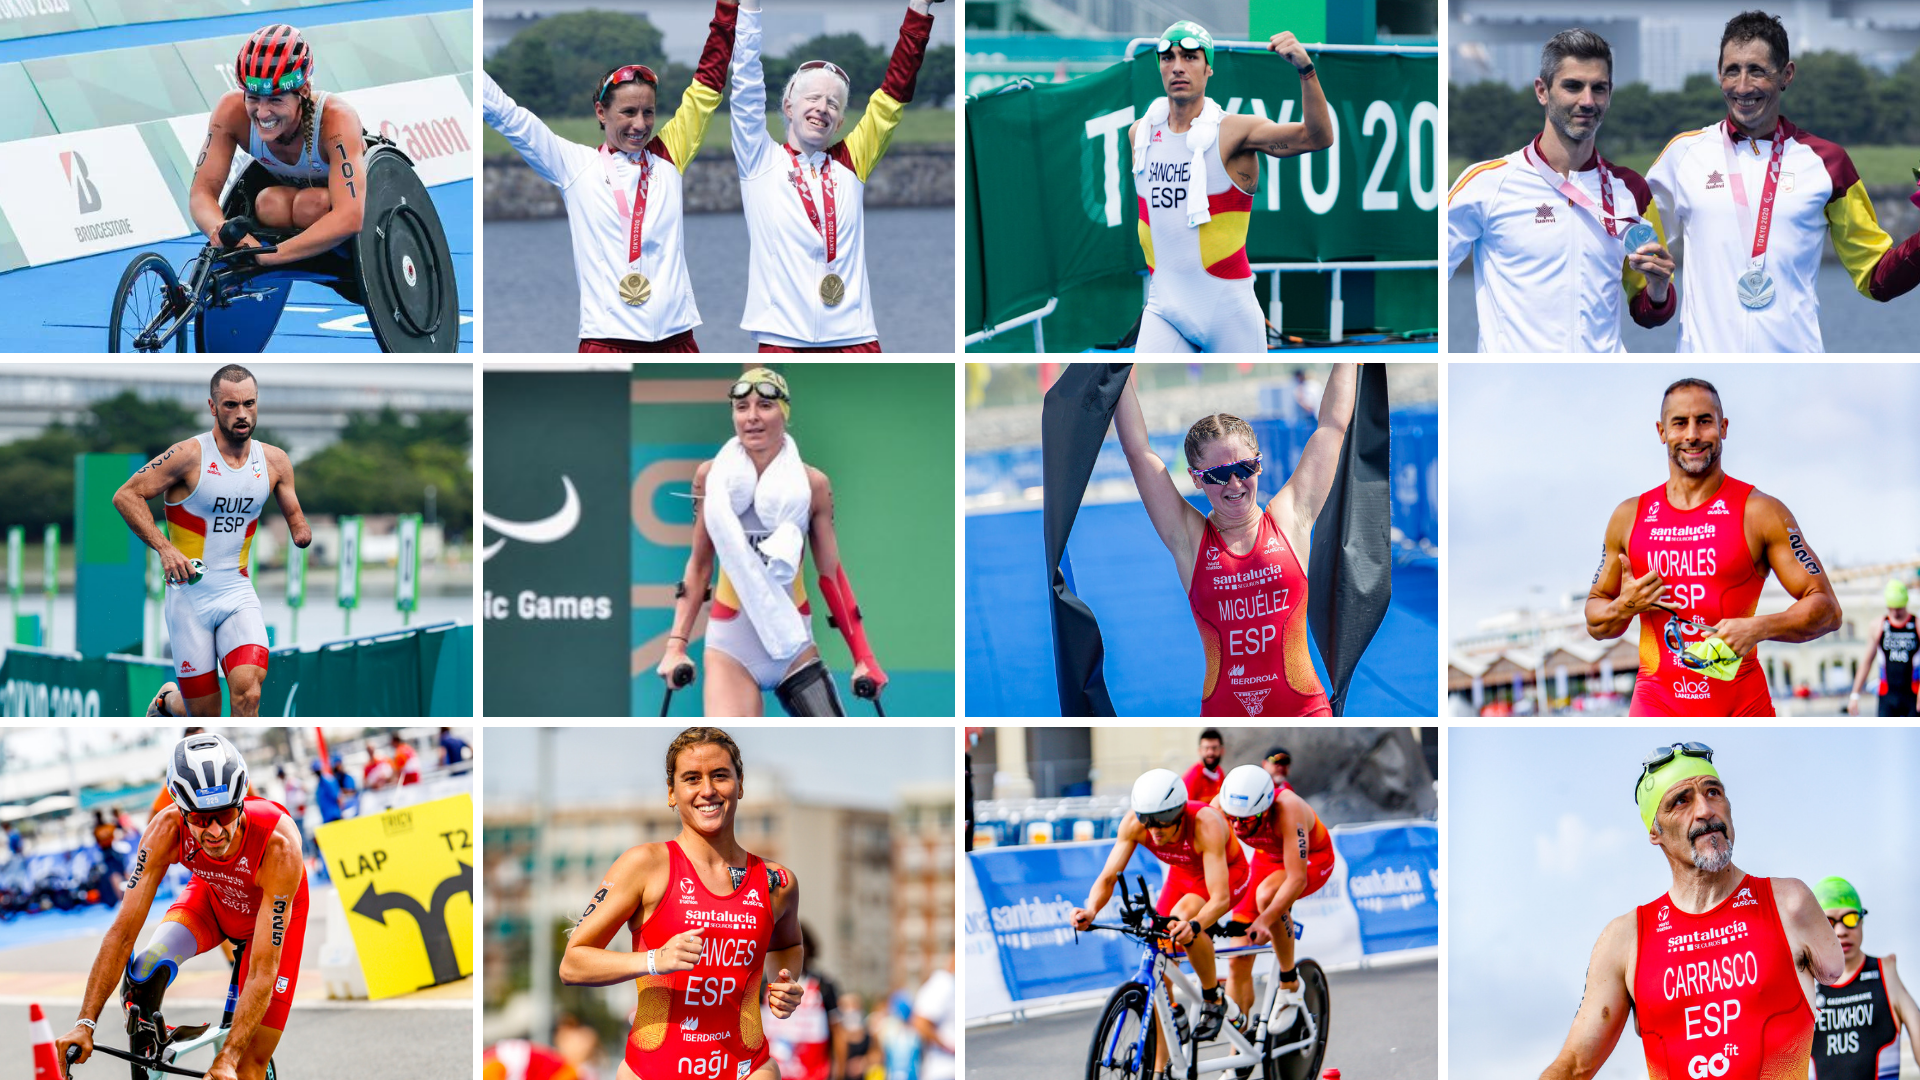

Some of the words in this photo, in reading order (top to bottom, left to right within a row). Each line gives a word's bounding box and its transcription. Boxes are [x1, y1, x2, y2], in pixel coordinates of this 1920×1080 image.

[282, 79, 294, 91] 101
[380, 115, 471, 162] Canon
[1085, 96, 1341, 229] TYO
[1151, 186, 1187, 209] ESP
[1760, 207, 1770, 225] 2020
[74, 217, 134, 243] BRIDGESTONE
[1756, 225, 1768, 248] TOKYO
[632, 233, 640, 254] TOKYO
[212, 496, 254, 514] RUIZ
[213, 516, 245, 533] ESP
[1650, 522, 1717, 537] santalucía
[1647, 547, 1717, 578] MORALES
[1788, 533, 1822, 576] 223
[1213, 563, 1283, 586] santalucía
[517, 589, 612, 620] Games
[1217, 588, 1291, 622] MIGUÉLEZ
[1229, 624, 1277, 656] ESP
[1230, 672, 1279, 685] IBERDROLA
[1673, 675, 1710, 693] aloe
[0, 677, 48, 717] OKYO
[1674, 692, 1711, 700] LANZAROTE
[205, 796, 219, 805] 325
[439, 829, 473, 851] T2
[1296, 827, 1308, 859] 628
[339, 850, 388, 879] LAP
[576, 887, 609, 927] 40
[1732, 898, 1759, 909] austral
[271, 900, 288, 947] 325
[685, 909, 757, 925] santalucía
[1667, 919, 1748, 948] santalucía
[1694, 939, 1721, 950] SEGUROS
[697, 937, 757, 967] ANCES
[1663, 950, 1758, 1001] CARRASCO
[684, 975, 737, 1007] ESP
[1684, 998, 1742, 1041] ESP
[682, 1030, 732, 1043] IBERDROLA
[1723, 1042, 1740, 1057] fit
[1826, 1030, 1860, 1057] RUS
[1687, 1052, 1731, 1080] GO
